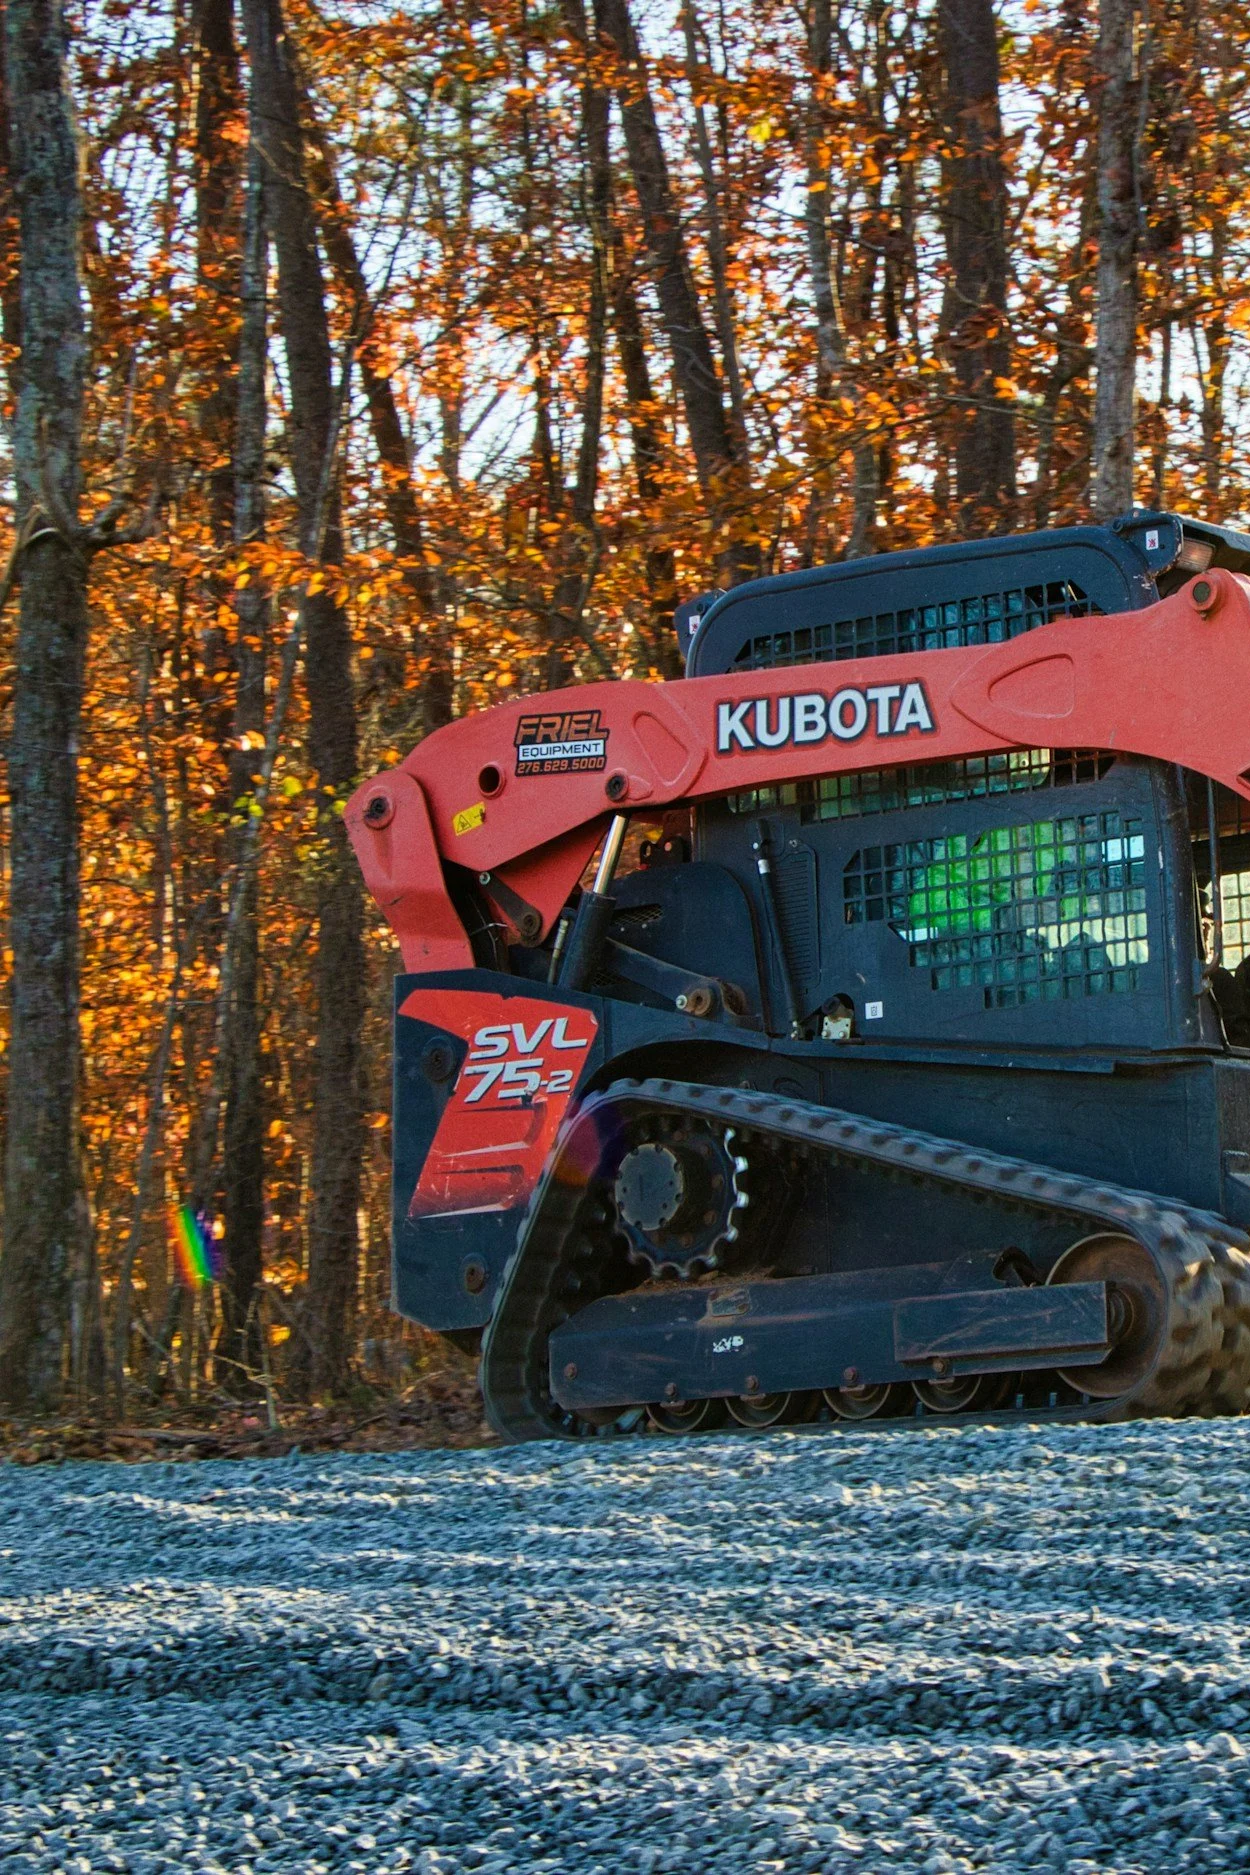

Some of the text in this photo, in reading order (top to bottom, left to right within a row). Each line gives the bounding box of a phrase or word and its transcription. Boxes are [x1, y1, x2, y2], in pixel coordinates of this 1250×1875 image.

[515, 713, 608, 745] FRIEL
[718, 683, 933, 750] KUBOTA
[517, 757, 605, 774] 276.629.5000
[522, 743, 601, 757] EQUIPMENT
[469, 1017, 588, 1060] SVL
